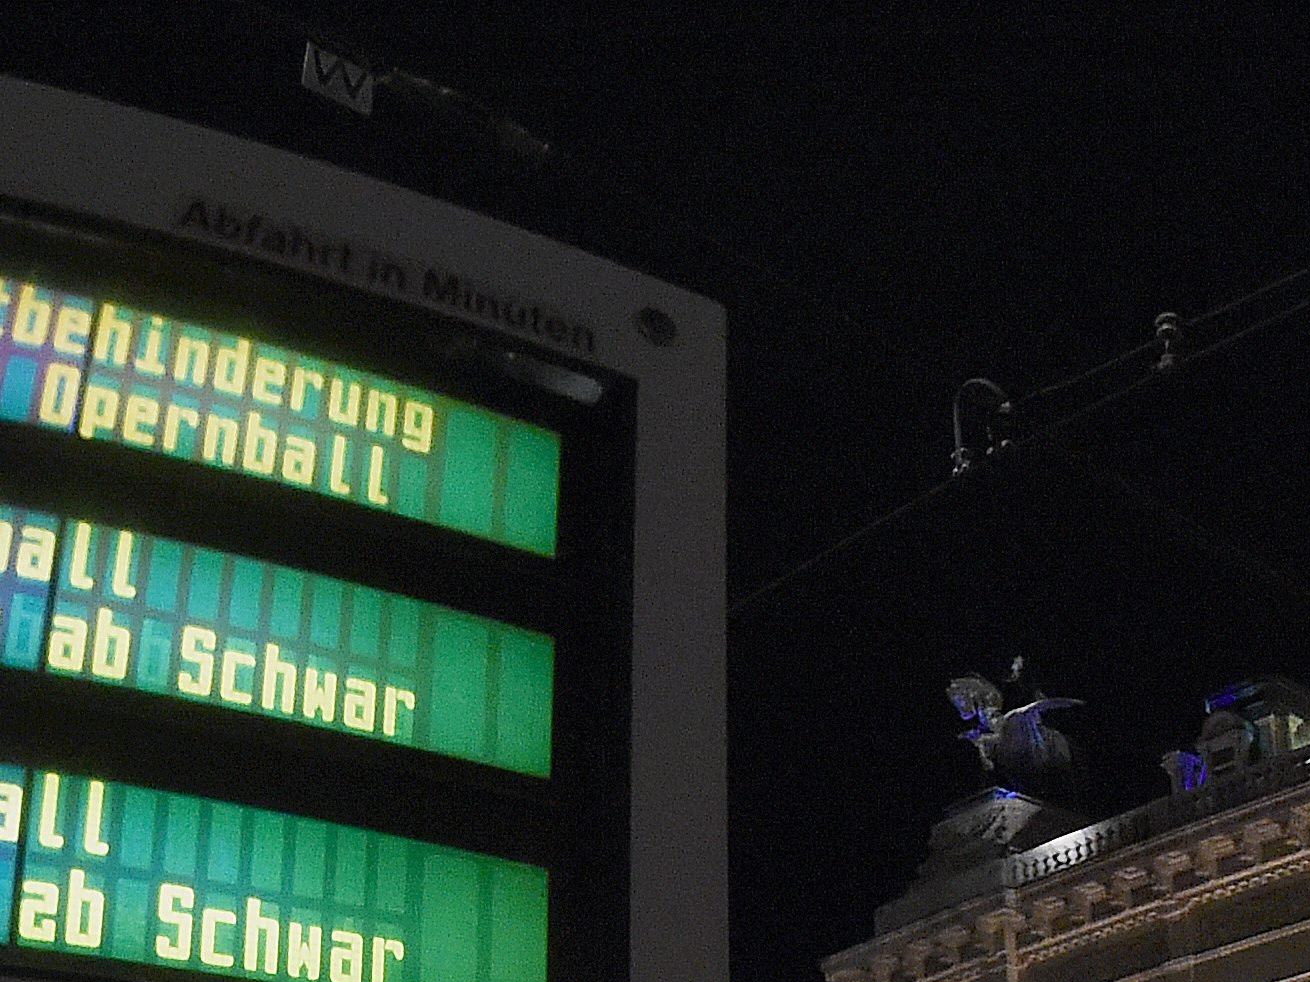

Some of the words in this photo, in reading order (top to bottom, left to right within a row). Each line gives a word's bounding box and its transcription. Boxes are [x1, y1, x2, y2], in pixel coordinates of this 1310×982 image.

[180, 199, 352, 272] Abfahrt
[367, 253, 408, 291] in
[423, 266, 597, 355] Minuten
[38, 361, 390, 506] Opernball
[47, 606, 132, 681] ab
[177, 624, 416, 737] Schwar
[18, 868, 105, 948] ab
